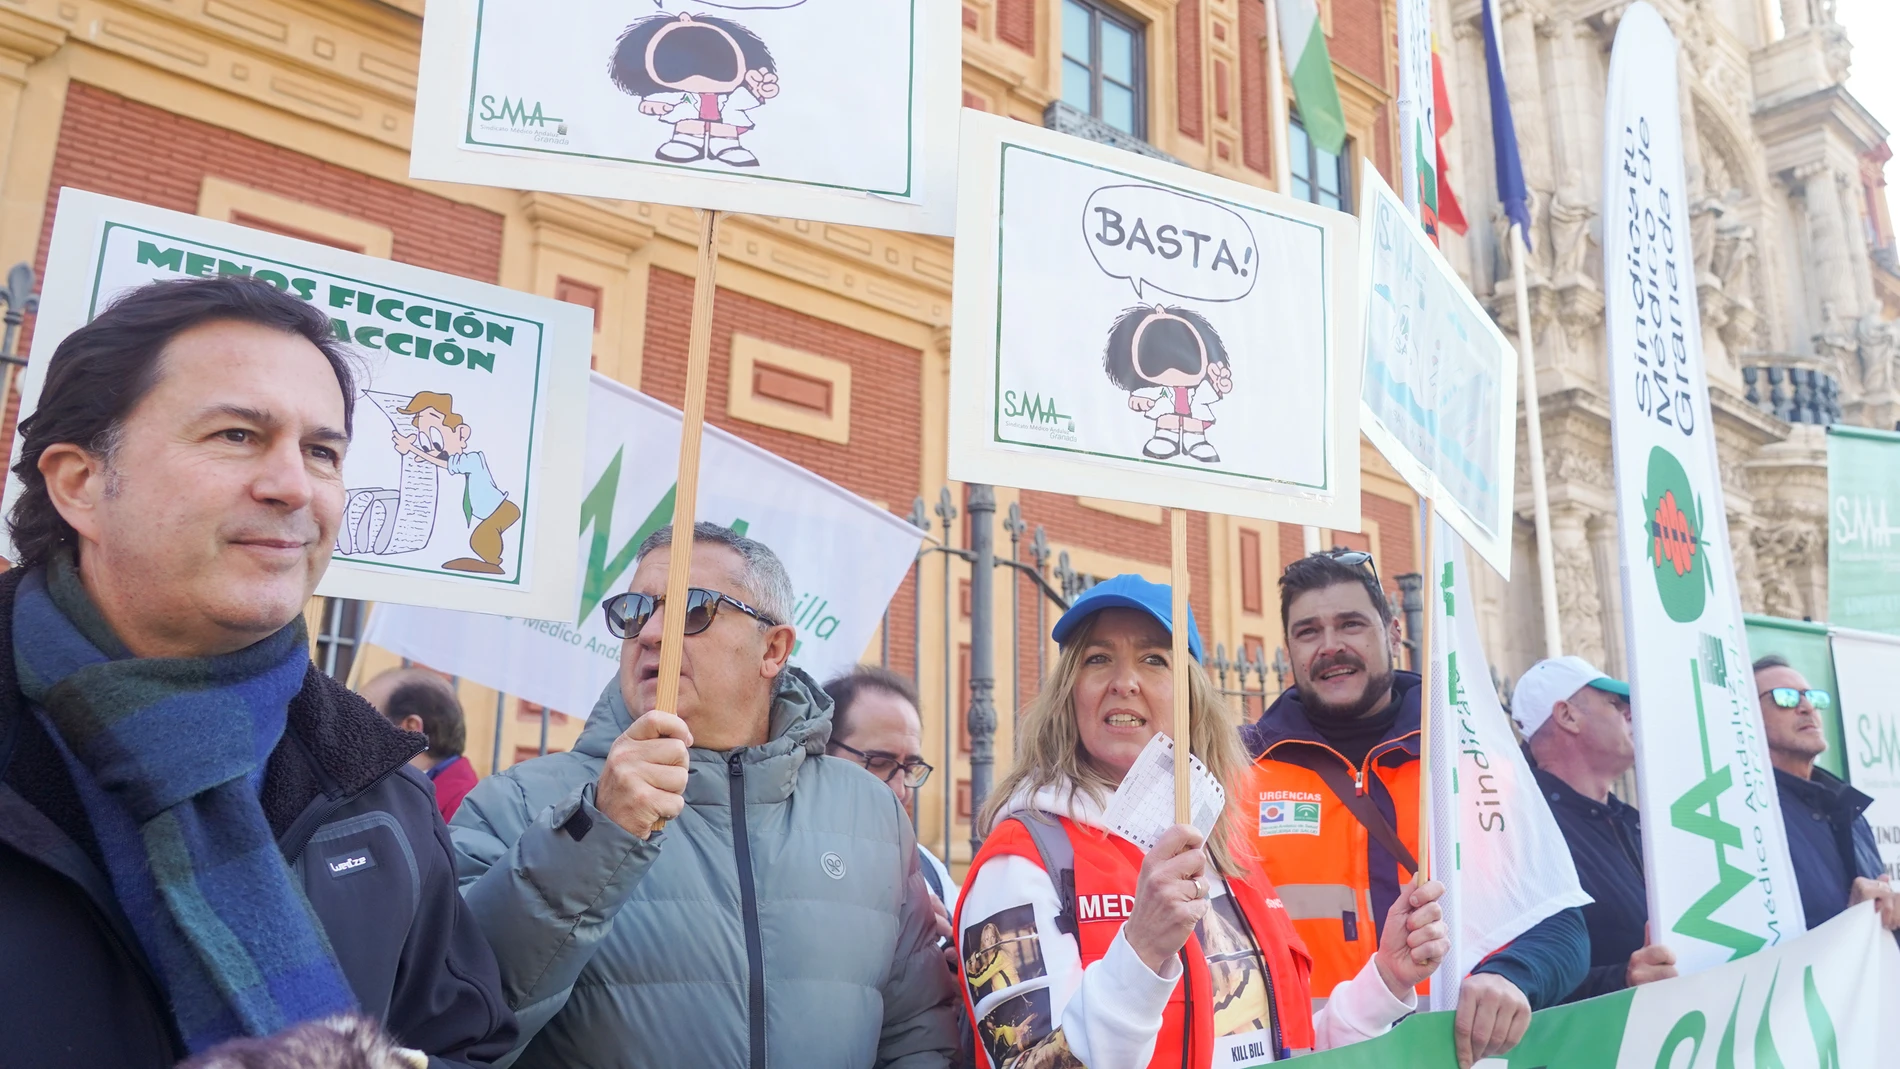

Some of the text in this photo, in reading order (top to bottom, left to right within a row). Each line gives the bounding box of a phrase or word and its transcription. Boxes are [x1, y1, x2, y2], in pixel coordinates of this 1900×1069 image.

[479, 94, 564, 128] SMA
[480, 124, 559, 138] Sindicato Médico Andaluz
[533, 134, 570, 146] Granada
[1093, 206, 1252, 278] BASTA!
[1637, 116, 1673, 427] Médico de
[328, 284, 515, 347] FICCIÓN
[1657, 187, 1694, 436] Granada
[329, 316, 496, 374] ACCIÓN
[1003, 390, 1071, 424] SMA
[1049, 432, 1078, 443] Granada
[1259, 790, 1322, 802] URGENCIAS
[1727, 678, 1782, 947] Médico Andaluz
[1078, 894, 1135, 919] MED
[1231, 1041, 1265, 1063] KILL BILL
